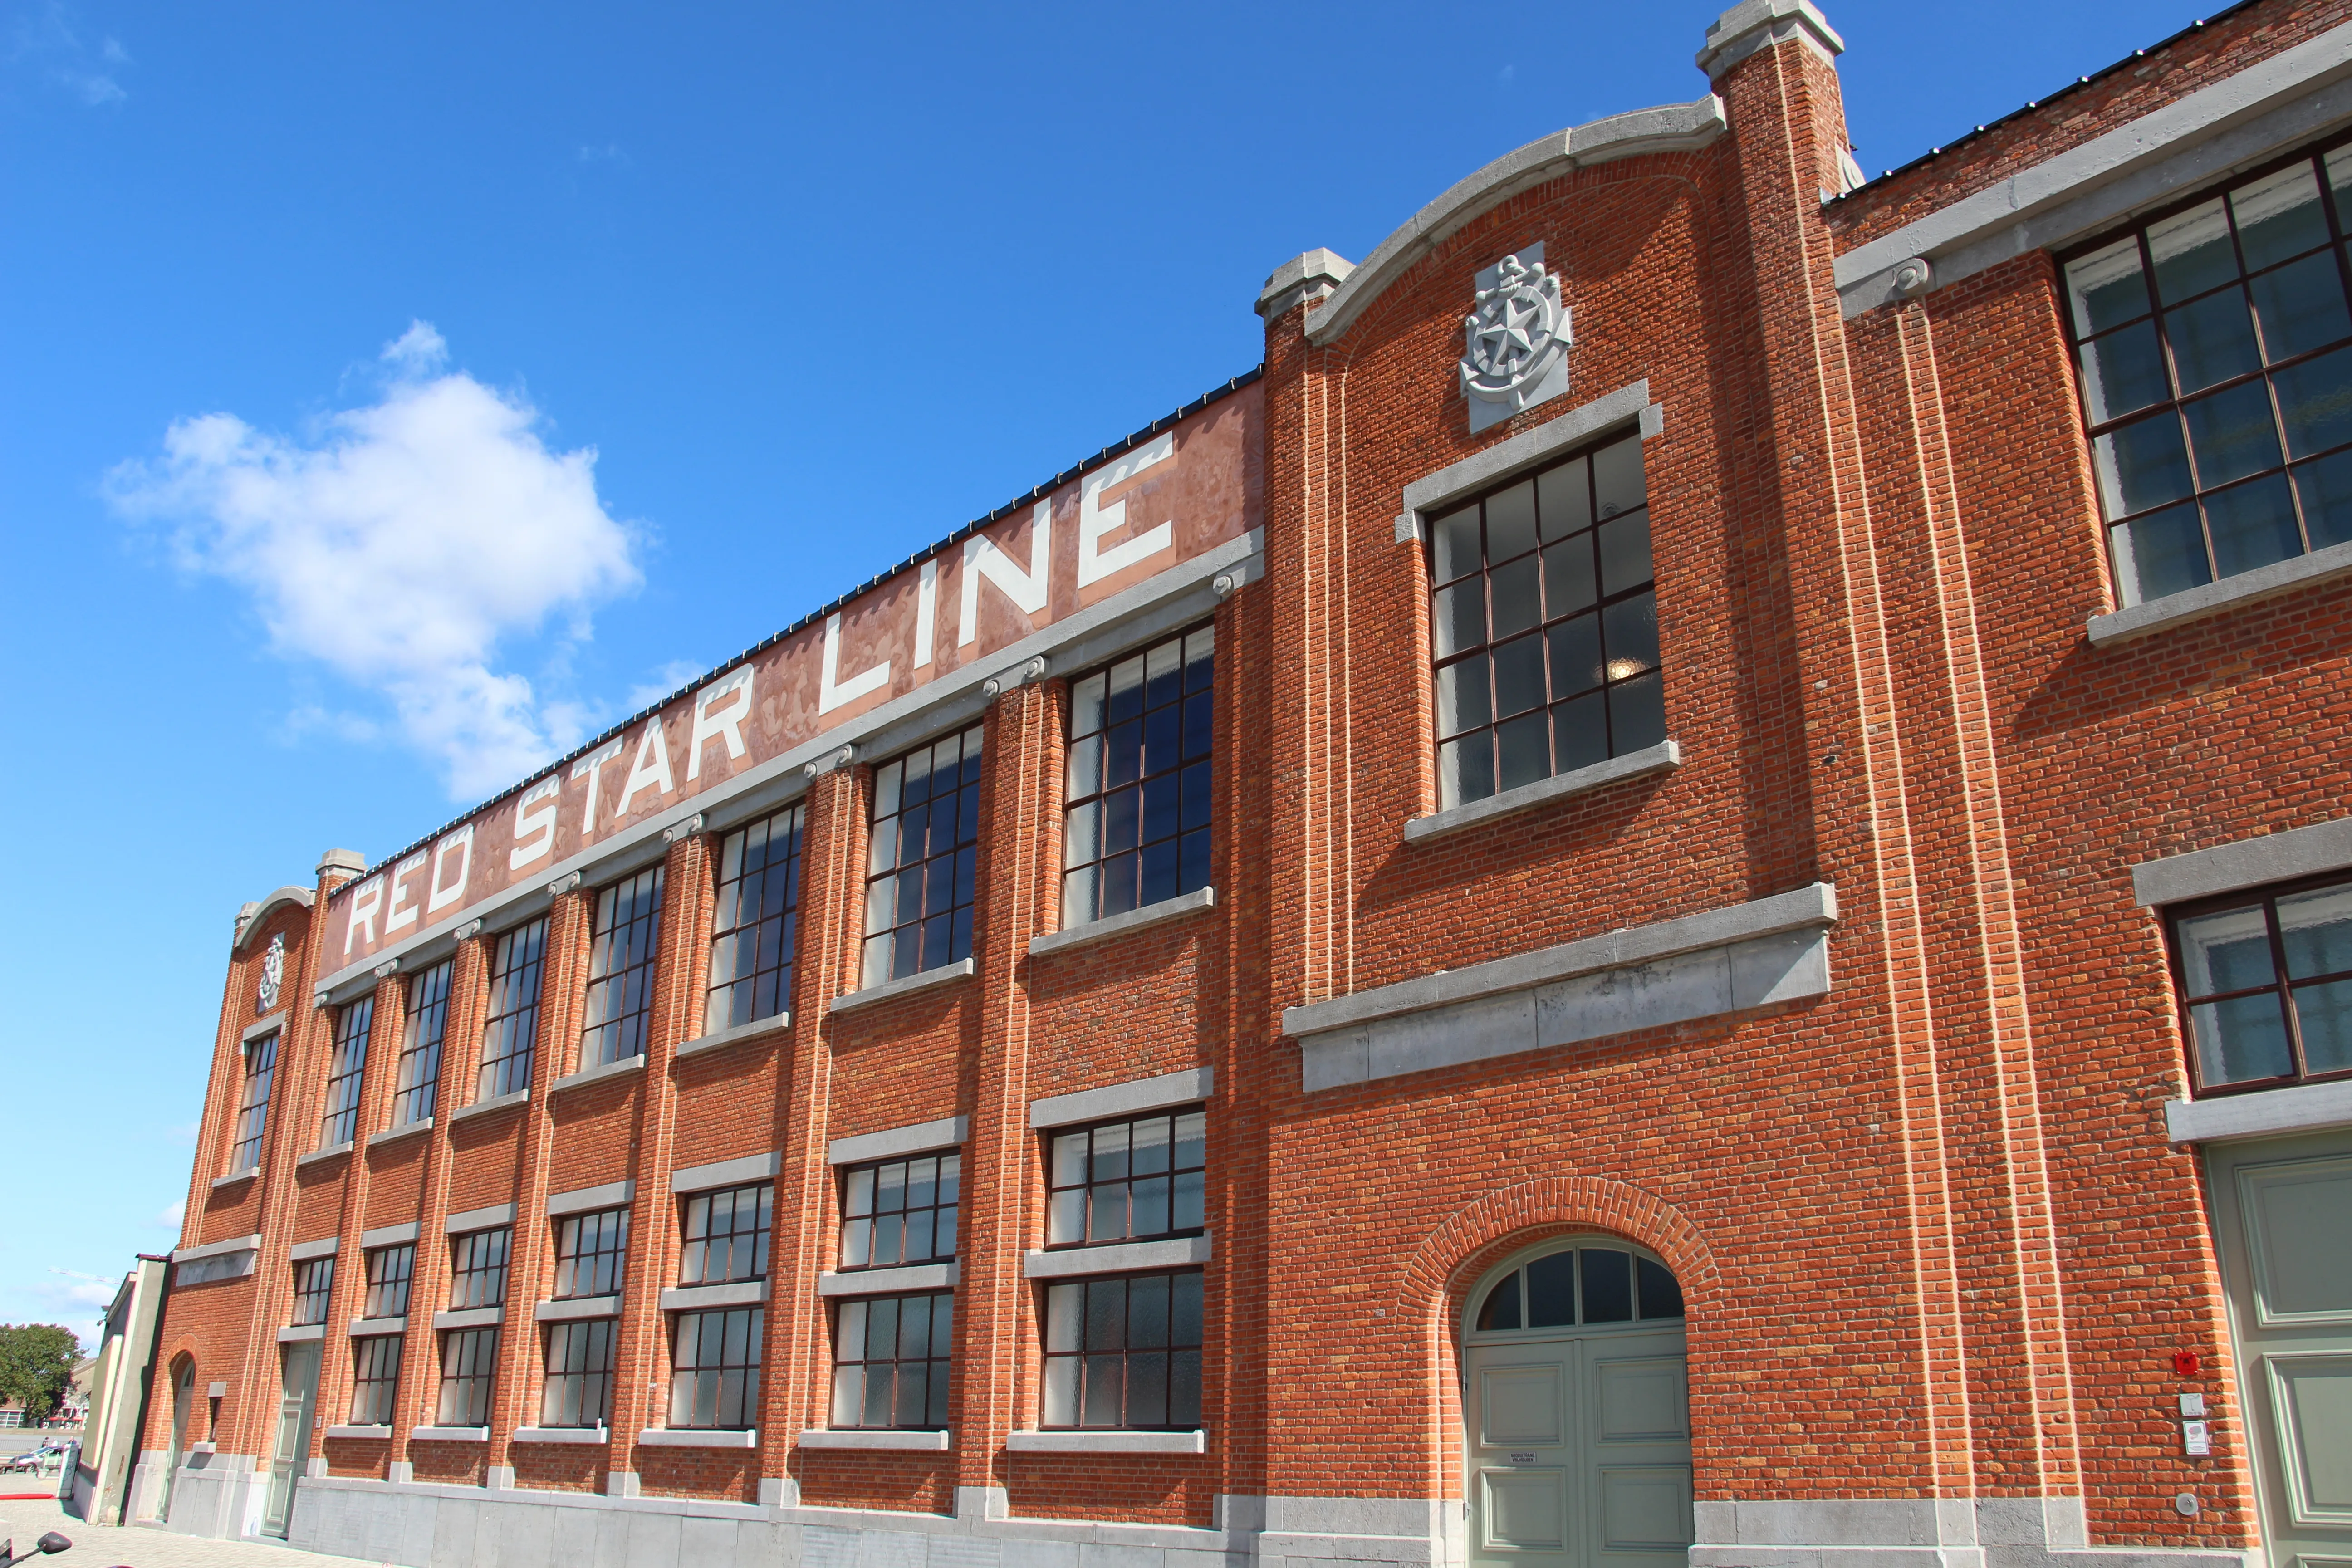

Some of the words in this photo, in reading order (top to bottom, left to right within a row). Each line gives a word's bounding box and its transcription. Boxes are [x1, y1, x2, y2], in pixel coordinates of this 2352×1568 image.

[343, 823, 474, 955] RED
[509, 662, 755, 871] STAR
[818, 430, 1173, 716] LINE
